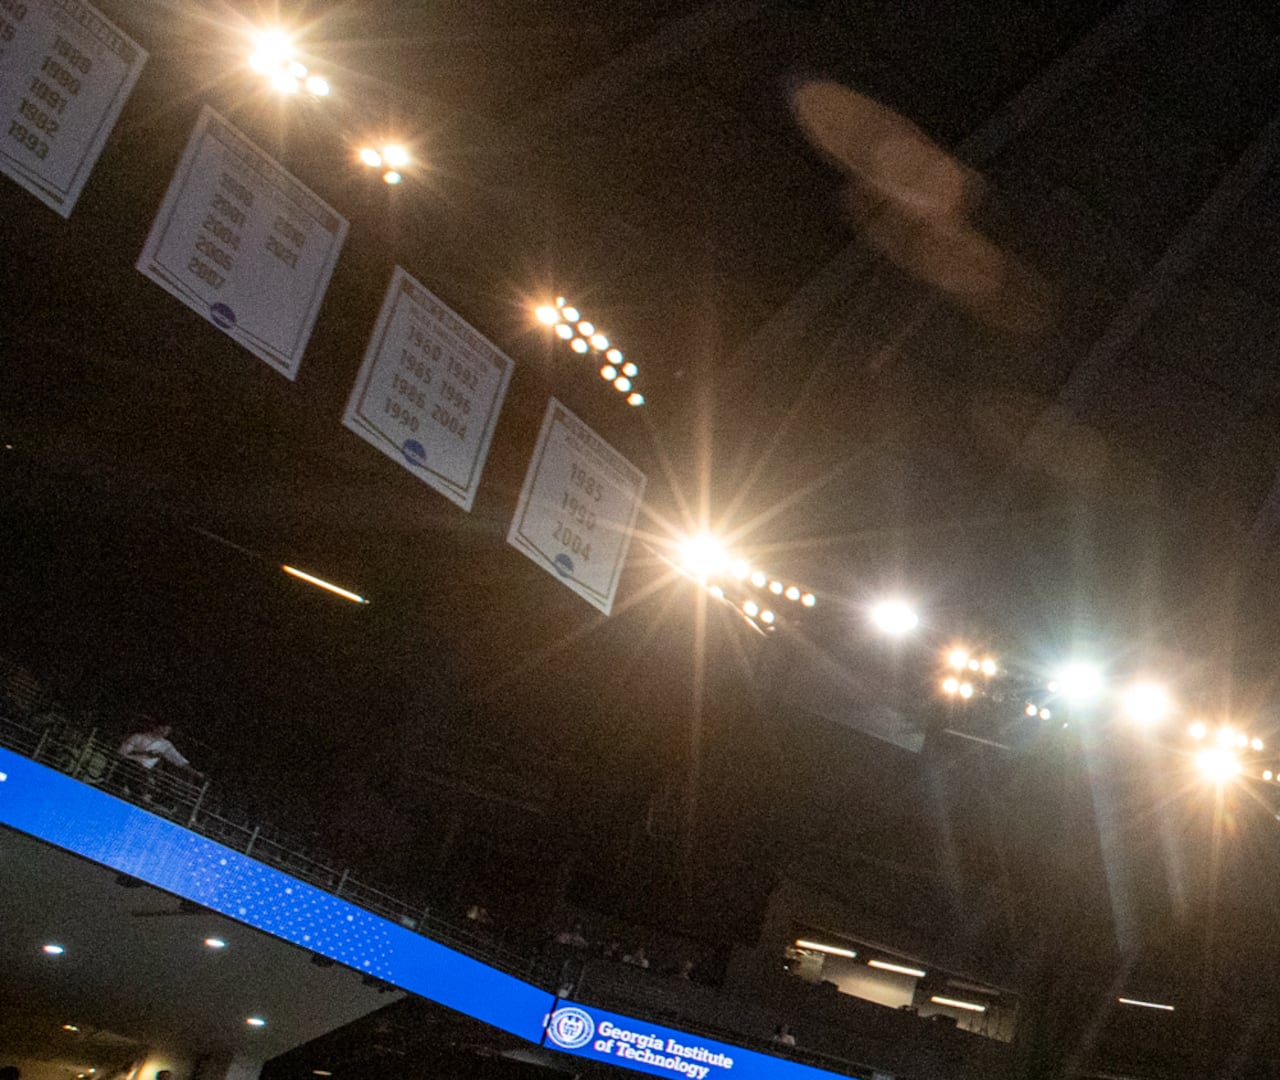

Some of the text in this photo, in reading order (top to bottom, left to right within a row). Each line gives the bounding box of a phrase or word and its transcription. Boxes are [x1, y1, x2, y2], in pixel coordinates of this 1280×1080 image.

[18, 98, 60, 138] 1992
[8, 120, 50, 160] 1993
[383, 397, 419, 432] 1990
[431, 404, 467, 441] 2004
[570, 463, 605, 502] 1985
[561, 492, 597, 531] 1990
[552, 520, 593, 562] 2004
[594, 1039, 710, 1080] of Technology
[597, 1021, 734, 1069] Georgia Institute
